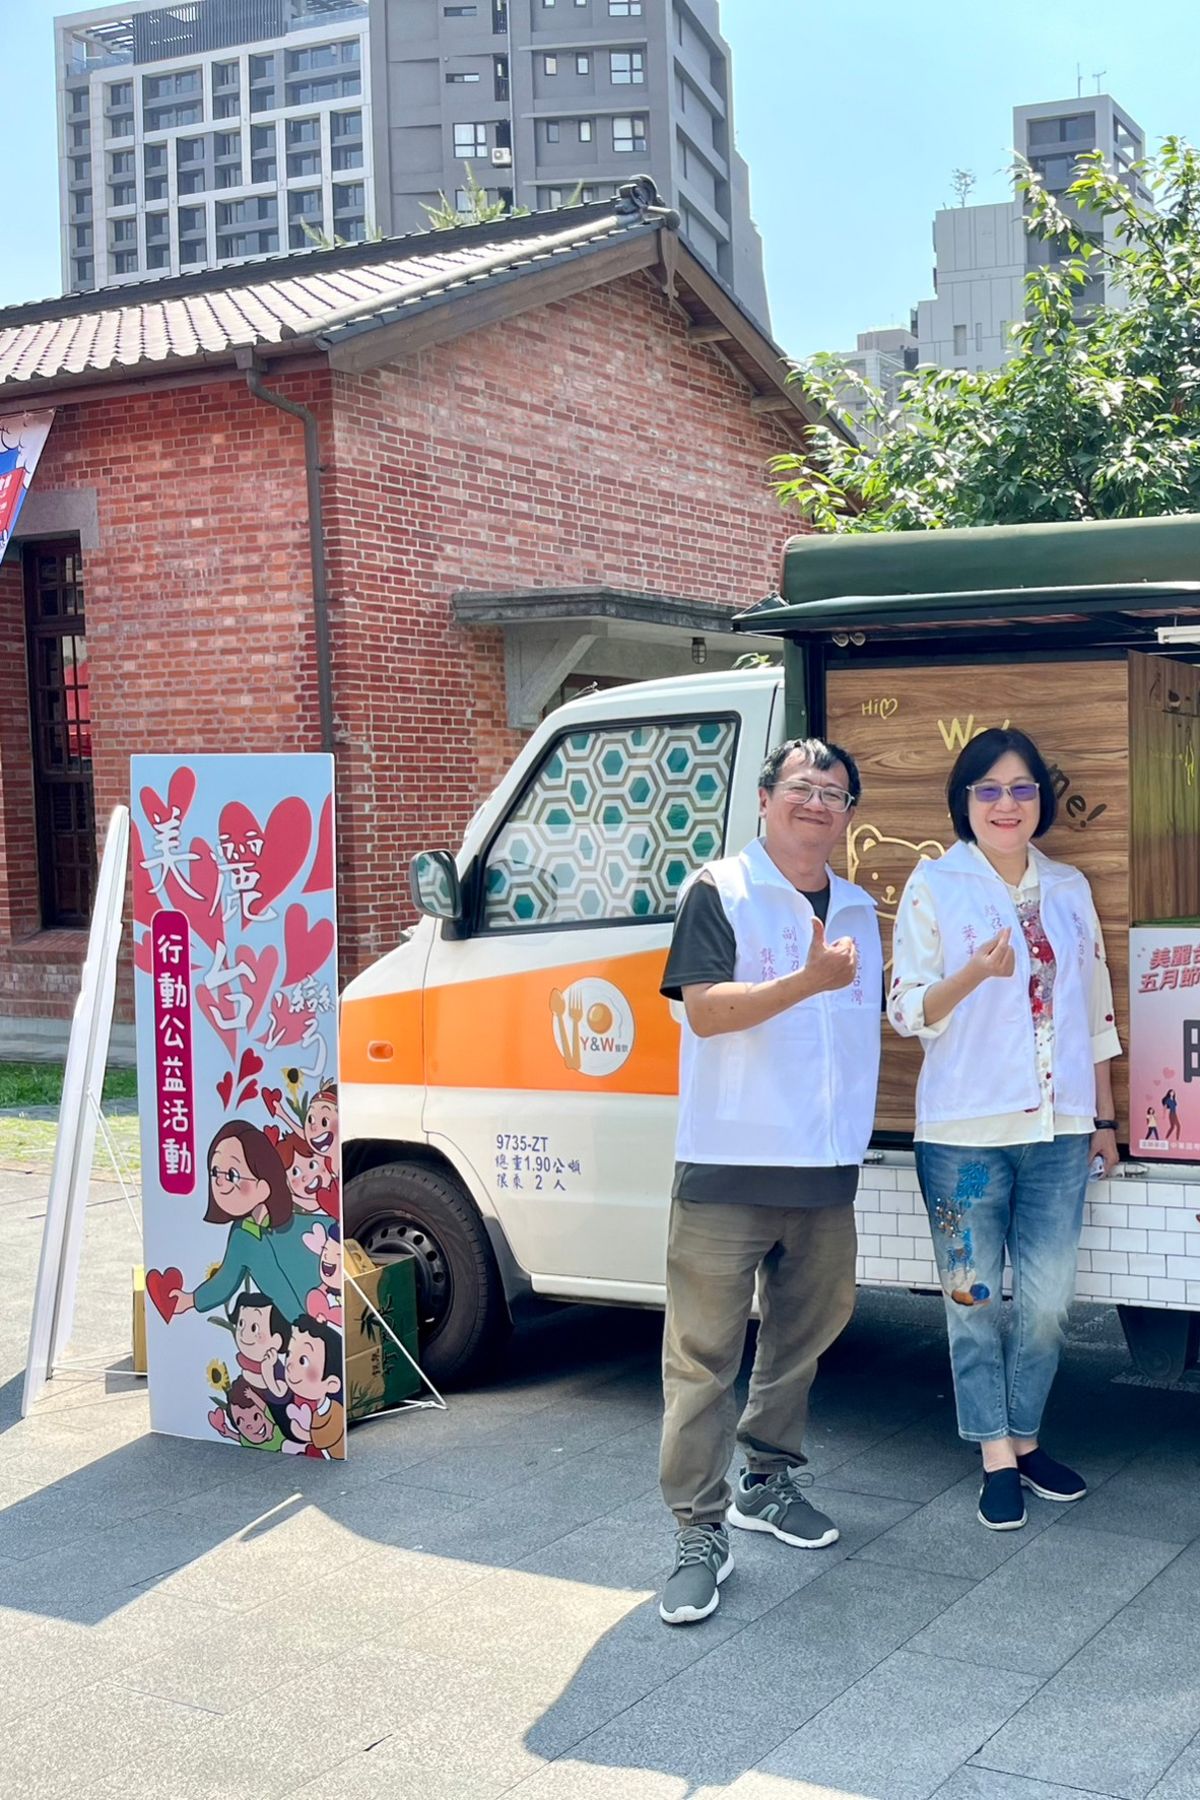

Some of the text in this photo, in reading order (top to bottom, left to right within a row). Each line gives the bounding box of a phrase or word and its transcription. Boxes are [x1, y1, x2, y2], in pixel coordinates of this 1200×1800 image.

[139, 805, 336, 1078] 美麗台灣
[157, 933, 193, 1177] 行動公益活動
[580, 1036, 614, 1052] Y&W
[496, 1133, 549, 1152] 9735-ZT
